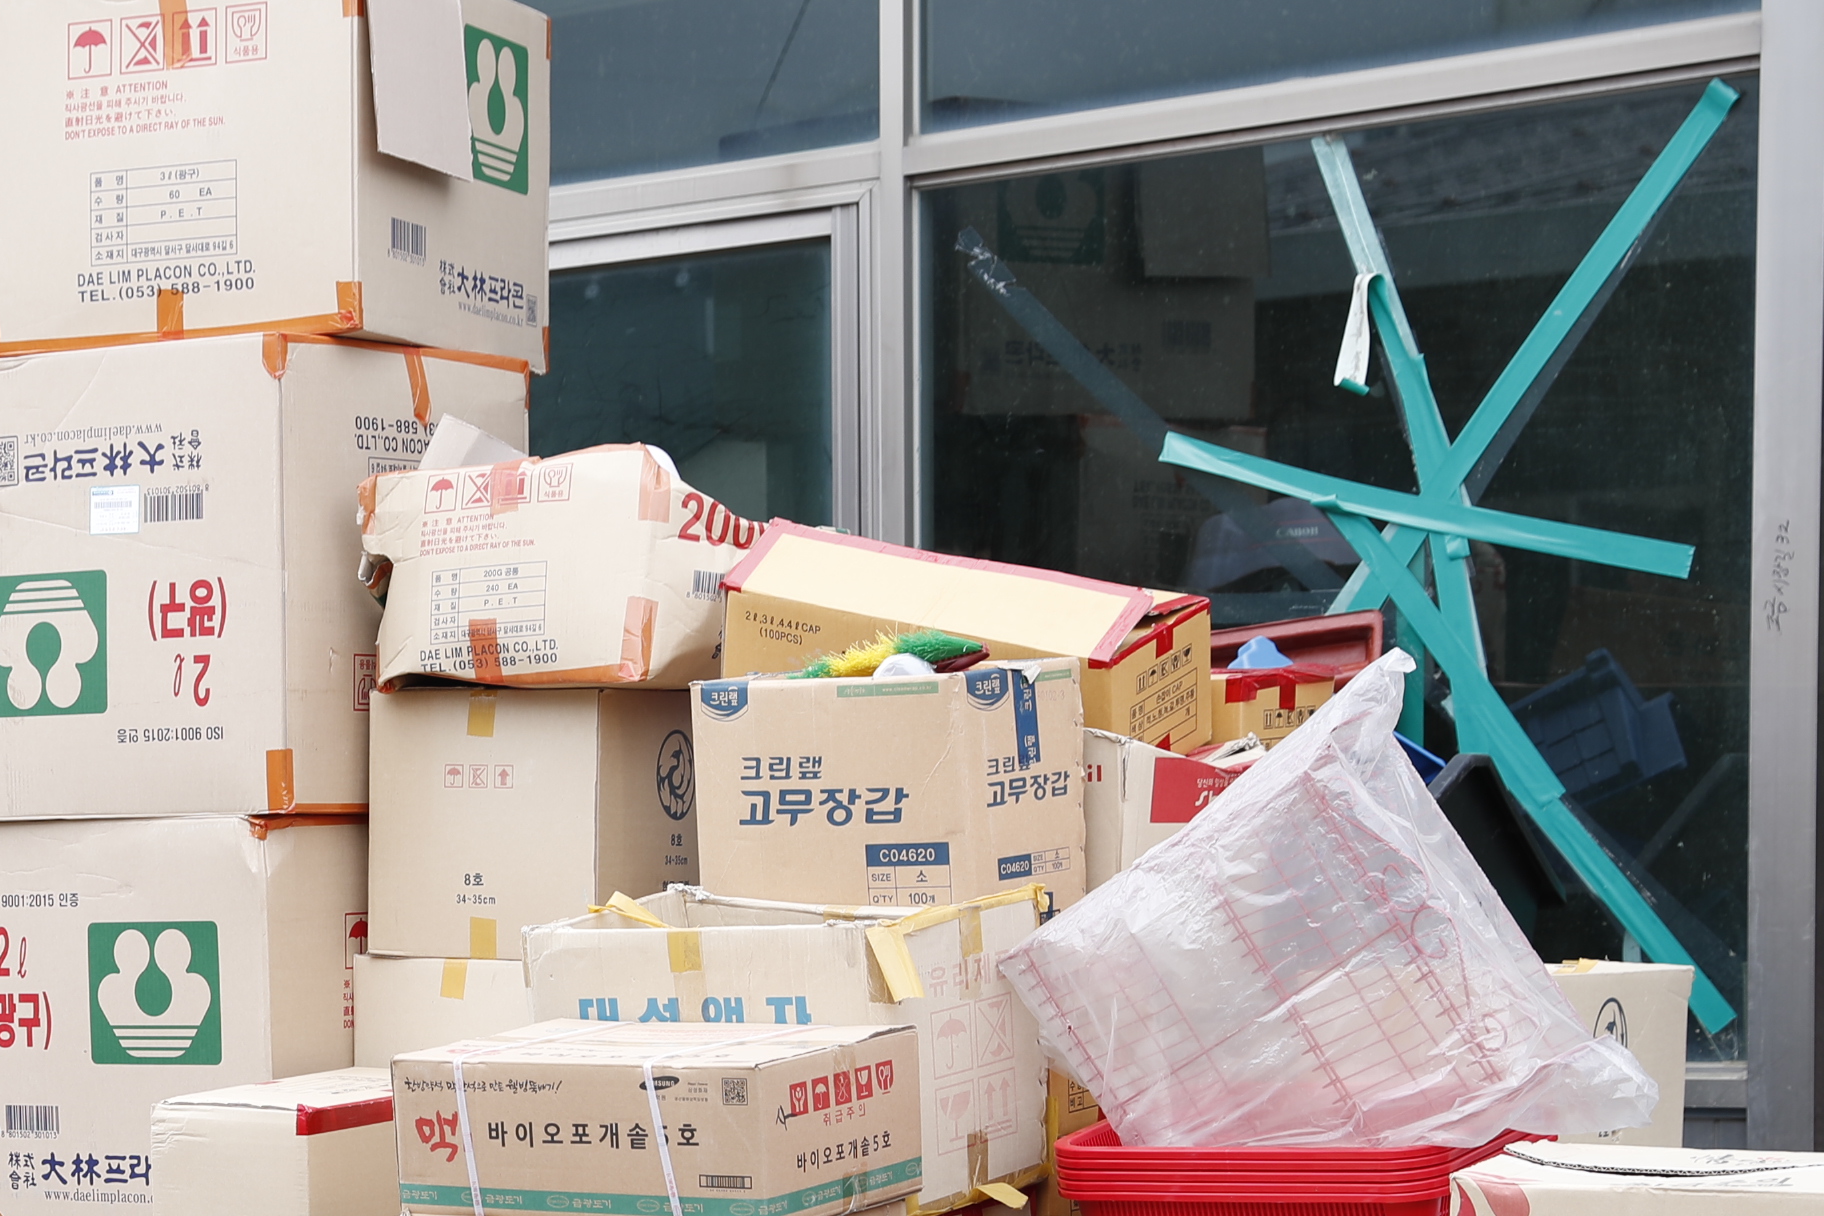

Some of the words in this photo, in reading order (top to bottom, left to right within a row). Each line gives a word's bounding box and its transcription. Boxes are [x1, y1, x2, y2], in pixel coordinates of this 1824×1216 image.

[233, 44, 260, 57] 식품용
[116, 80, 168, 95] ATTENTION
[65, 128, 86, 141] DON'T
[87, 125, 116, 139] EXPOSE
[117, 124, 127, 136] TO
[136, 121, 163, 134] DIRECT
[164, 120, 179, 131] RAY
[181, 118, 191, 129] OF
[192, 117, 207, 128] THE
[208, 116, 226, 127] SUN.
[168, 190, 180, 200] 60
[199, 187, 212, 197] EA
[95, 231, 124, 243] 검사자
[95, 250, 124, 261] 소재지
[131, 245, 162, 258] 대구광역시
[164, 244, 183, 255] 달서구
[185, 241, 211, 254] 달서대로
[212, 240, 227, 252] 94길
[77, 272, 104, 287] DAE
[109, 269, 131, 285] LIM
[137, 264, 192, 282] PLACON
[198, 259, 256, 277] CO.,LTD.
[78, 285, 162, 303] TEL.(053)
[170, 276, 254, 296] 588-1900
[457, 265, 524, 310] 大林프라콘
[458, 301, 523, 328] www.daelimplacon.co.kr
[354, 415, 419, 434] 588-1900
[24, 422, 163, 447] www.daelimplacon.co.kr
[354, 433, 399, 452] CO.,LTD.
[23, 440, 165, 483] 大林프라콘
[457, 514, 494, 524] ATTENTION
[678, 492, 765, 549] 200
[484, 568, 502, 578] 200G
[486, 584, 499, 592] 240
[508, 582, 518, 590] EA
[148, 577, 227, 641] (광구)
[760, 627, 803, 645] (100PCS)
[420, 650, 441, 661] DAE
[445, 648, 463, 660] LIM
[467, 644, 510, 657] PLACON
[514, 639, 558, 653] CO.,LTD.
[495, 653, 557, 667] 588-1900
[710, 687, 738, 706] 크린랲
[117, 728, 139, 744] 인증
[144, 727, 202, 743] 9001:2015
[206, 726, 224, 740] ISO
[740, 755, 823, 781] 크린랲
[986, 771, 1070, 808] 고무장갑
[739, 786, 910, 827] 고무장갑
[671, 834, 683, 847] 8호
[879, 848, 935, 863] C04620
[871, 873, 892, 882] SIZE
[915, 870, 928, 883] 소
[1000, 860, 1029, 876] C04620
[464, 873, 484, 887] 8호
[1, 893, 54, 908] 9001:2015
[58, 892, 79, 908] 인증
[456, 894, 496, 905] 34~35cm
[872, 894, 893, 905] Q'TY
[908, 892, 936, 905] 100개
[823, 1102, 866, 1126] 취급주의
[415, 1110, 459, 1163] 맥
[796, 1130, 892, 1173] 바이오포개솥5호
[572, 1197, 612, 1210] 금광도기
